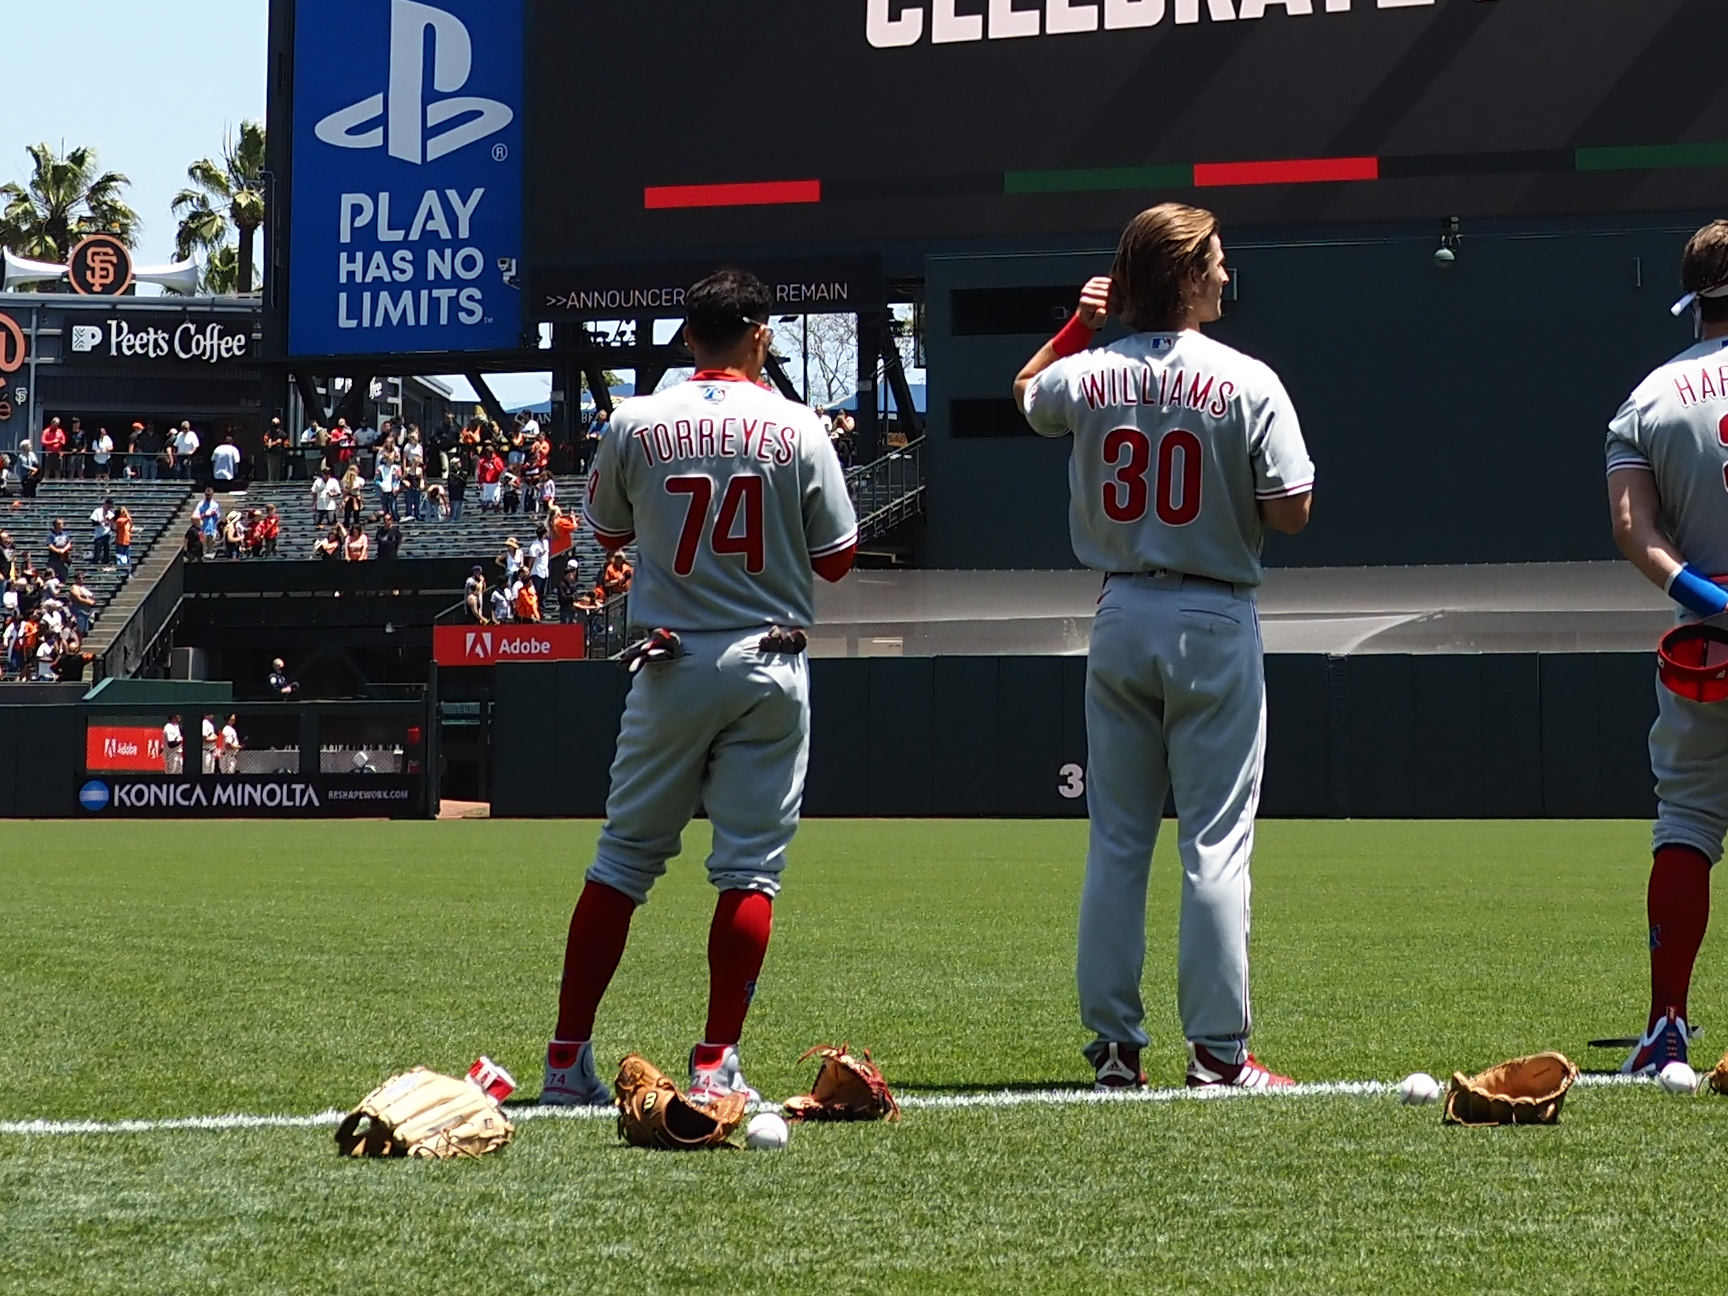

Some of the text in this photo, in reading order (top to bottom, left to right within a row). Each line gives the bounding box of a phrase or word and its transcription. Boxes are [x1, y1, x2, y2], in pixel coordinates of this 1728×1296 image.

[339, 187, 486, 244] PLAY
[339, 247, 484, 284] HAS NO
[338, 288, 484, 329] LIMITS
[776, 282, 849, 303] REMAIN
[106, 318, 169, 357] Peet's
[175, 322, 247, 364] Coffee
[1080, 366, 1238, 419] WILLIAMS
[632, 417, 797, 469] TORREYES
[1101, 425, 1204, 527] 30
[663, 472, 766, 578] 74
[498, 638, 551, 656] Adobe
[113, 783, 208, 808] KONICA
[213, 782, 320, 808] MINOLTA
